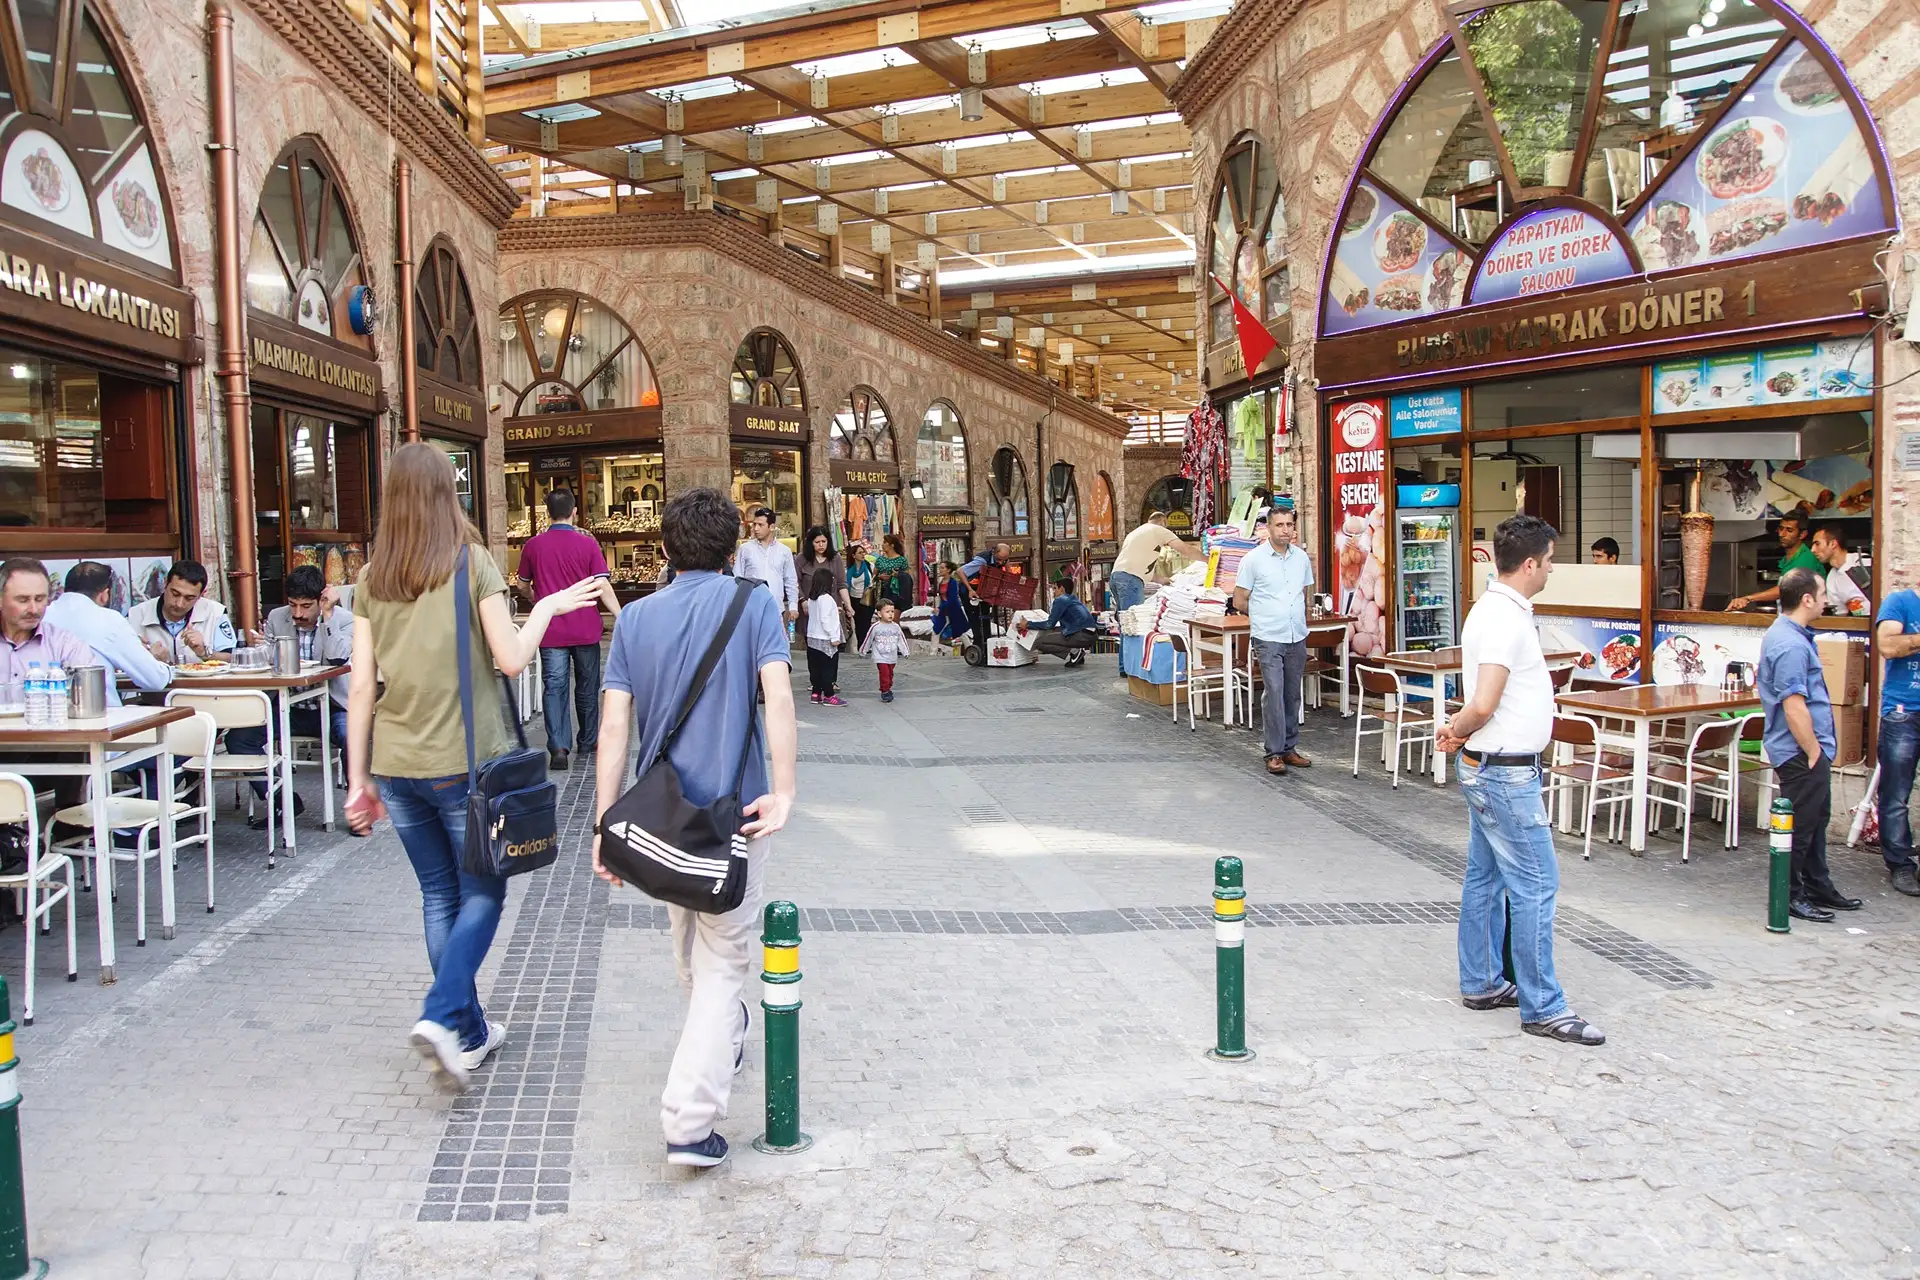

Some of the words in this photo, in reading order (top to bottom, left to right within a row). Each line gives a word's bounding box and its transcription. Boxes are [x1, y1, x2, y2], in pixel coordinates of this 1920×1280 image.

[1507, 212, 1585, 247] PAPATYAM
[1487, 252, 1534, 277] DÖNER
[1539, 245, 1556, 265] VE
[1561, 232, 1613, 260] BÖREK
[1519, 267, 1577, 295] SALONU
[56, 270, 181, 339] LOKANTASI
[1501, 305, 1608, 351] YAPRAK
[1618, 288, 1725, 335] DÖNER
[1741, 280, 1757, 316] 1
[253, 337, 317, 379] MARMARA
[318, 366, 376, 397] LOKANTASI
[453, 401, 472, 422] OPTİK
[1408, 397, 1421, 408] Üst
[1423, 396, 1444, 407] Katta
[1396, 411, 1412, 421] Aile
[1412, 407, 1458, 419] Salonumuz
[506, 427, 552, 440] GRAND
[557, 423, 593, 437] SAAT
[746, 417, 776, 431] GRAND
[778, 421, 799, 433] SAAT
[1414, 420, 1439, 430] Vardır
[1335, 449, 1384, 474] KESTANE
[867, 470, 888, 485] ÇEYİZ
[1341, 477, 1379, 510] ŞEKERİ
[1591, 620, 1611, 629] TAVUK
[1658, 624, 1665, 632] ET
[506, 837, 548, 857] adidas
